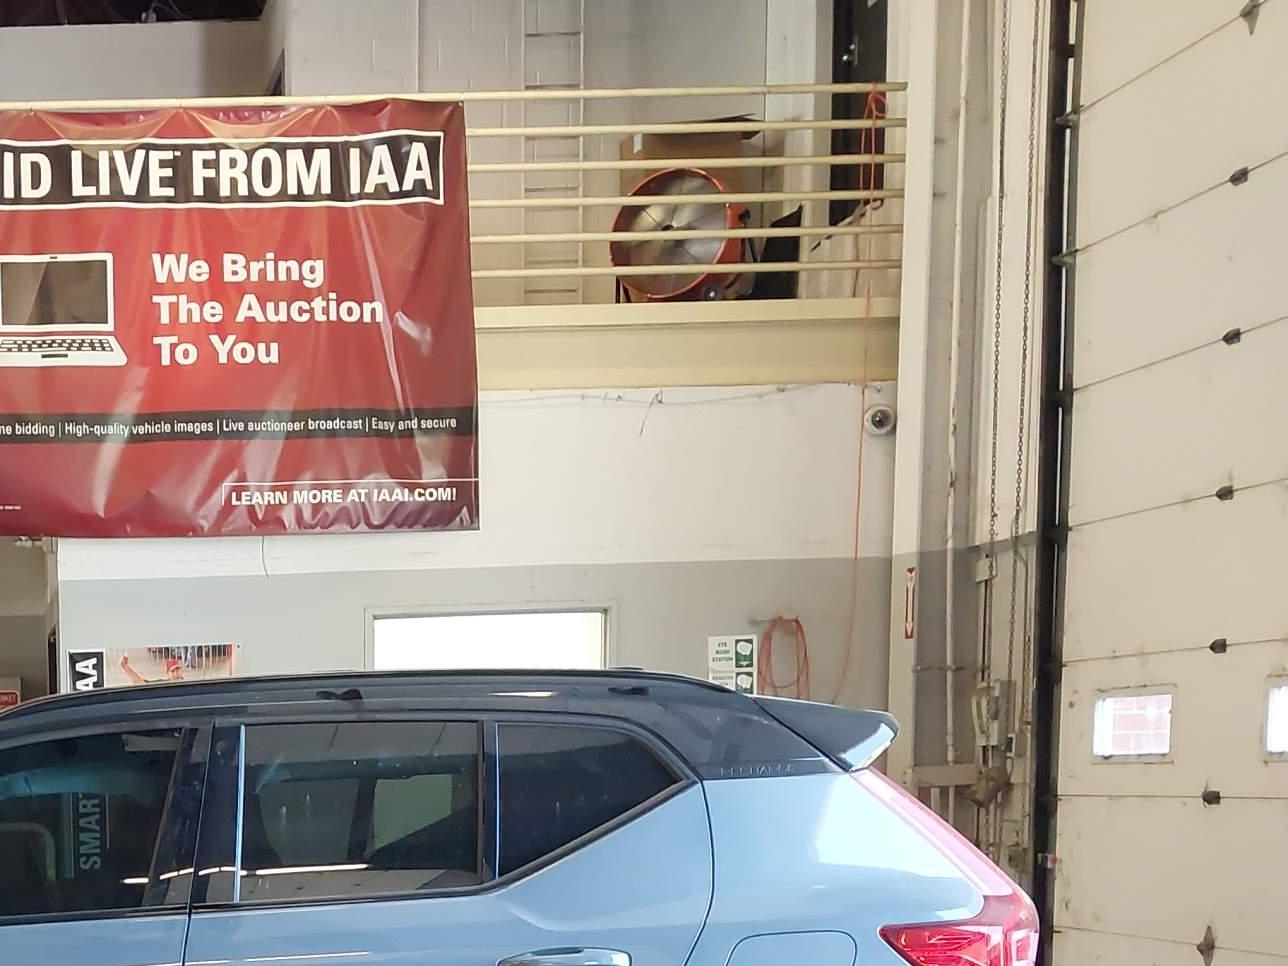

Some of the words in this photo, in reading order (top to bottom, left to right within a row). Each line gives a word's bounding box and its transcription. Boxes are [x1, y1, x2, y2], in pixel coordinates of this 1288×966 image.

[71, 149, 176, 197] LIVE
[192, 147, 332, 198] FROM
[349, 141, 434, 195] IAA
[151, 252, 210, 284] We
[222, 251, 325, 289] Bring
[151, 294, 225, 325] The
[234, 292, 385, 324] Auction
[152, 335, 199, 366] To
[208, 333, 280, 365] You
[15, 422, 56, 438] bidding
[64, 421, 130, 437] High-quality
[131, 420, 171, 435] vehicle
[174, 420, 214, 434] images
[223, 419, 245, 432] Live
[247, 420, 305, 432] auctioneer
[308, 417, 363, 430] broadcast
[372, 417, 395, 433] Easy
[397, 416, 418, 430] and
[420, 418, 457, 430] secure
[231, 491, 288, 506] LEARN
[293, 489, 343, 504] MORE
[346, 489, 368, 502] AT
[373, 487, 457, 502] IAAI.COM!
[75, 657, 98, 691] AA
[78, 793, 102, 870] SMAR
